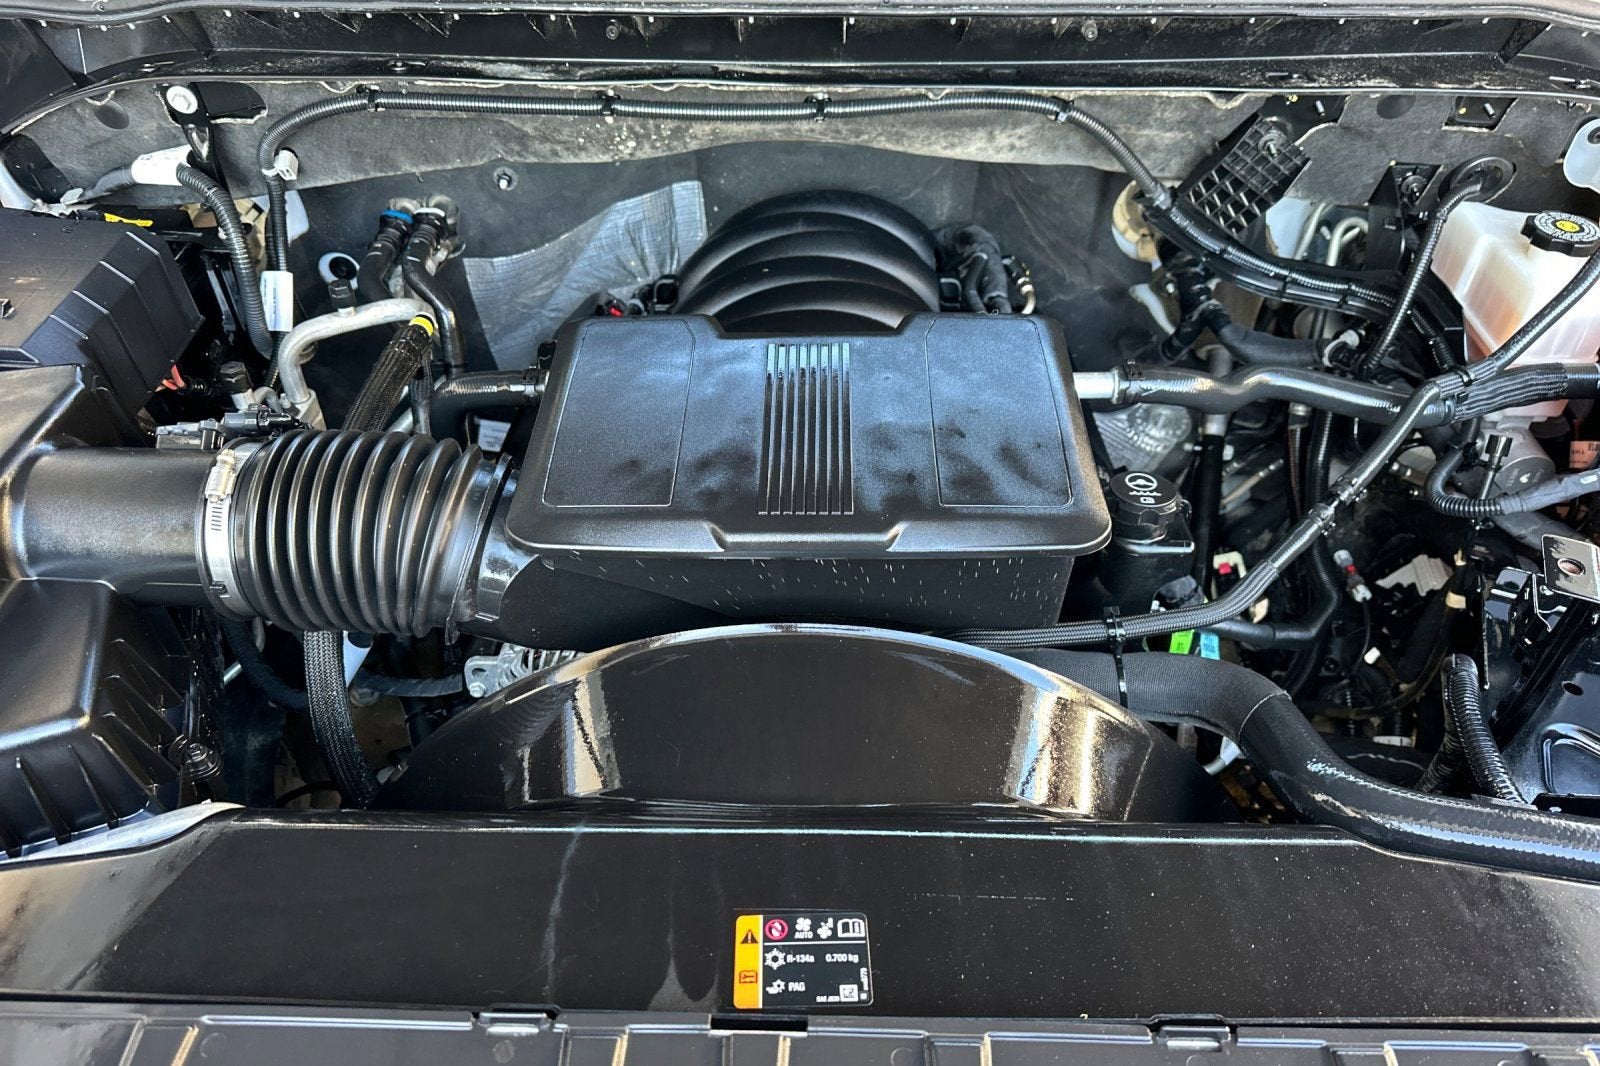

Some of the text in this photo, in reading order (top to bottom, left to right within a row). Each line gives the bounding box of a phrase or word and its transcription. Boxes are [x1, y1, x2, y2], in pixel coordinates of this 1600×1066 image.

[794, 931, 813, 939] AUTO
[786, 953, 860, 964] R-134a 0.700 kg
[788, 982, 806, 992] PAG
